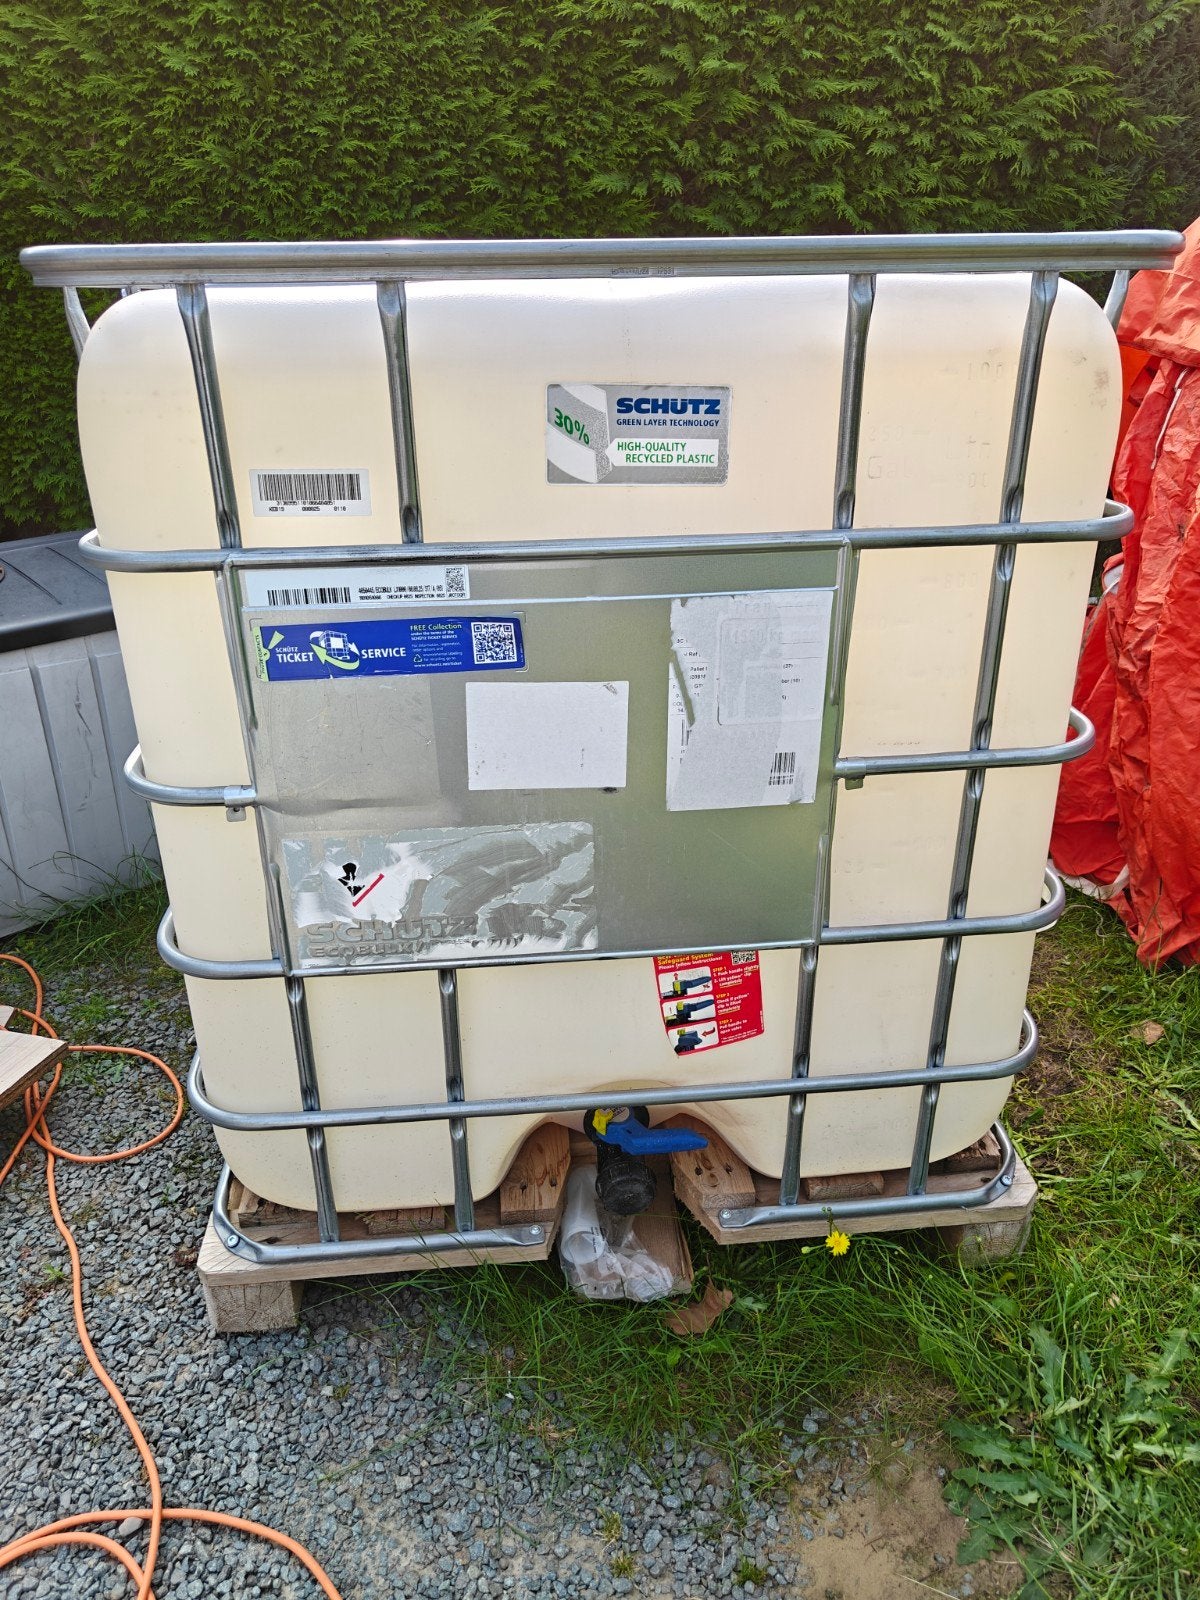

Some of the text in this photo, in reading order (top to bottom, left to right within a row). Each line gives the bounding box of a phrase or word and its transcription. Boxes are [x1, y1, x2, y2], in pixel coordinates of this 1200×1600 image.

[616, 398, 720, 414] SCHÜTZ
[554, 408, 590, 446] 30%
[617, 442, 687, 452] HIGH-QUALITY
[625, 454, 715, 464] RECYCLED PLASTIC
[276, 652, 314, 663] TICKET
[362, 647, 406, 659] SERVICE
[657, 956, 690, 965] Safeguard
